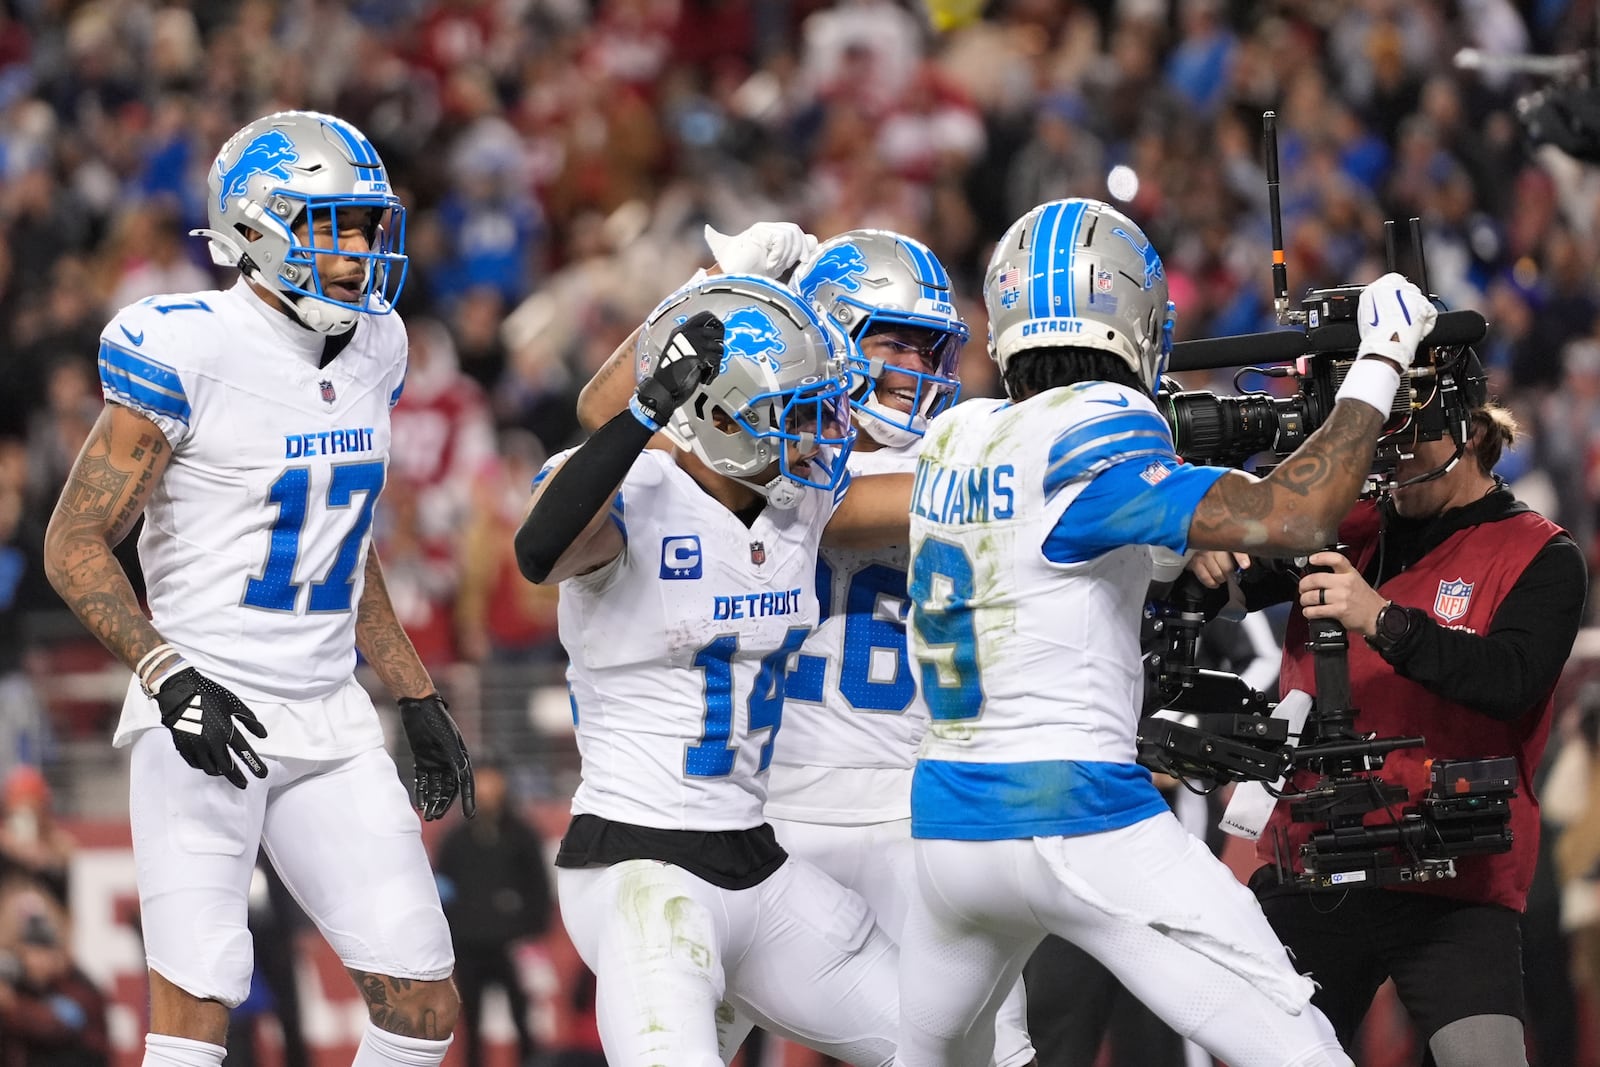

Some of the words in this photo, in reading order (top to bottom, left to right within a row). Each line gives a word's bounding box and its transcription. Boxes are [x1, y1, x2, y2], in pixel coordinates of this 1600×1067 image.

[931, 301, 952, 315] LIONS
[1054, 295, 1062, 306] 9
[1022, 320, 1083, 337] DETROIT
[284, 427, 374, 459] DETROIT
[238, 461, 387, 615] 17
[664, 538, 700, 569] C
[713, 588, 802, 621] DETROIT
[1438, 595, 1465, 616] NFL
[908, 534, 987, 723] 9
[682, 625, 813, 780] 14
